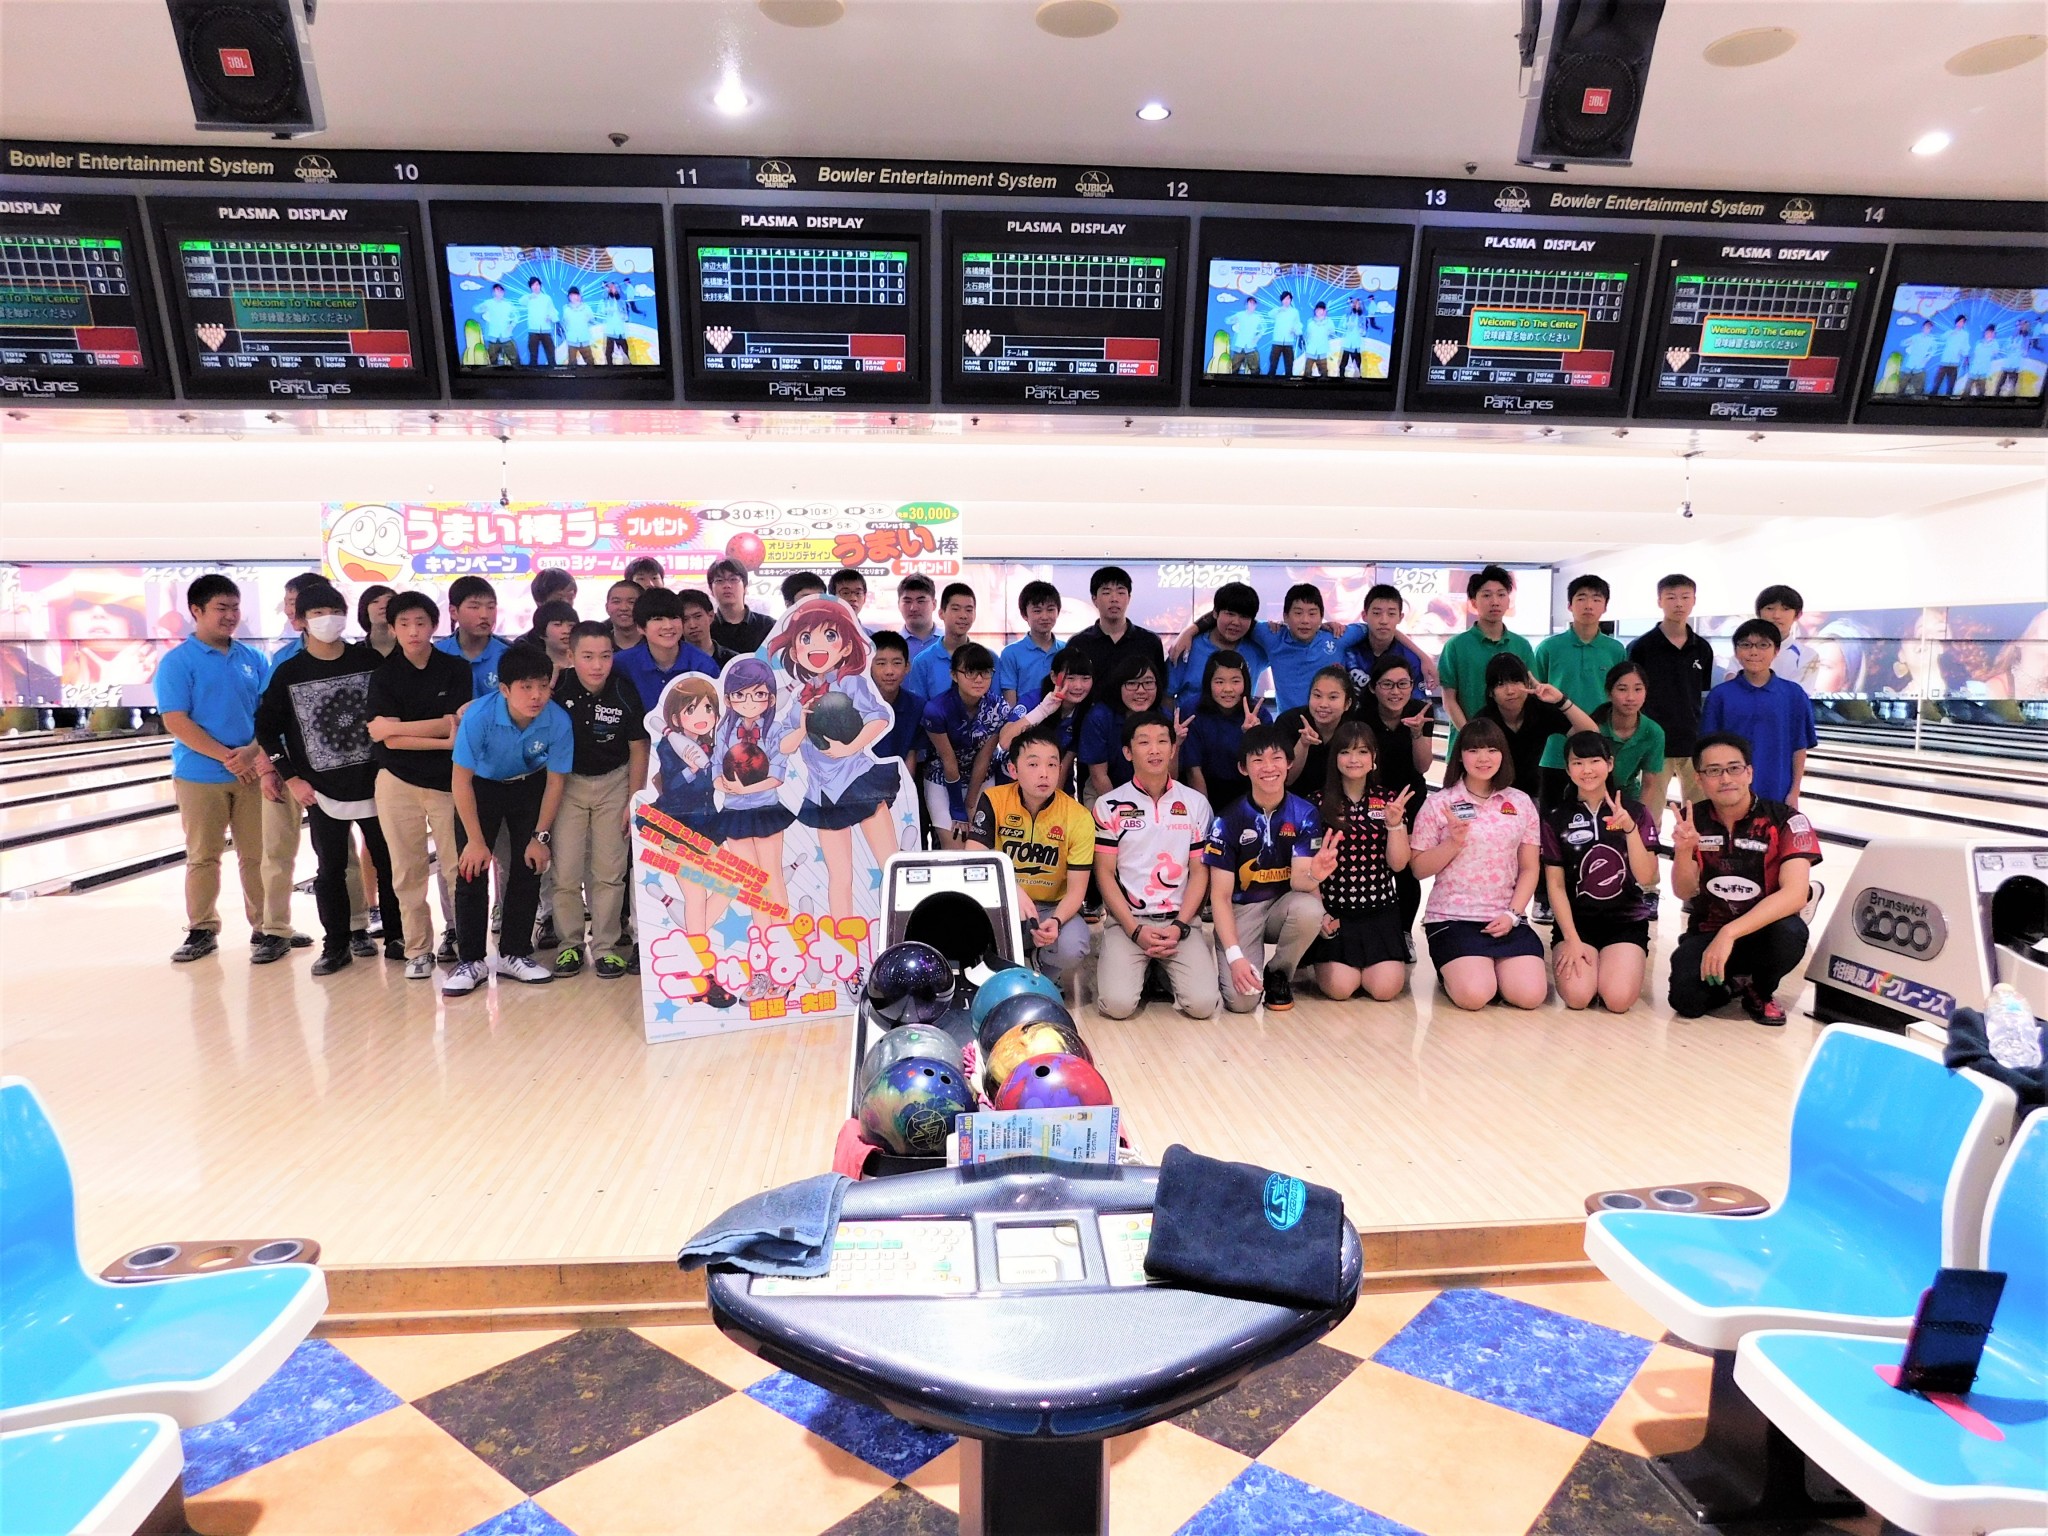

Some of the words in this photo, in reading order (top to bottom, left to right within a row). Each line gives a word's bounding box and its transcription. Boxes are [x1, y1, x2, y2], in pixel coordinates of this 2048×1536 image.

[228, 56, 247, 69] JBL
[1589, 96, 1604, 107] JBL
[9, 150, 73, 169] Bowler
[79, 154, 204, 174] Entertainment
[209, 158, 275, 178] System
[294, 168, 338, 179] QUBICA
[394, 164, 419, 181] 10
[676, 168, 698, 185] 11
[755, 172, 797, 184] QUBICA
[817, 166, 876, 184] Bowler
[879, 169, 994, 188] Entertainment
[997, 172, 1058, 190] System
[1074, 182, 1115, 194] QUBICA
[1166, 182, 1189, 198] 12
[1425, 189, 1447, 206] 13
[1494, 198, 1531, 209] QUBICA
[0, 202, 62, 215] DISPLAY
[1550, 192, 1602, 210] Bowler
[1605, 195, 1707, 215] Entertainment
[1710, 200, 1765, 219] System
[218, 207, 280, 220] PLASMA
[288, 208, 349, 221] DISPLAY
[1780, 209, 1815, 221] QUBICA
[1864, 206, 1886, 223] 14
[741, 215, 798, 227] PLASMA
[806, 217, 864, 229] DISPLAY
[1007, 221, 1063, 233] PLASMA
[1070, 222, 1126, 235] DISPLAY
[1484, 236, 1536, 249] PLASMA
[1543, 239, 1596, 251] DISPLAY
[1721, 246, 1771, 259] PLASMA
[1778, 249, 1829, 261] DISPLAY
[241, 299, 285, 308] Welcome
[288, 299, 301, 308] To
[304, 299, 322, 308] The
[324, 300, 357, 309] Center
[1478, 318, 1517, 327] Welcome
[1520, 318, 1530, 327] To
[1533, 320, 1548, 328] The
[1550, 320, 1578, 329] Center
[1711, 326, 1747, 335] Welcome
[1750, 327, 1760, 335] To
[1763, 327, 1777, 336] The
[1779, 328, 1807, 337] Center
[34, 378, 79, 392] Lanes
[270, 380, 307, 394] Park
[308, 380, 351, 394] Lanes
[769, 382, 802, 396] Park
[805, 383, 846, 396] Lanes
[1025, 386, 1057, 399] Park
[1060, 386, 1100, 400] Lanes
[1484, 396, 1514, 408] Park
[1517, 397, 1554, 410] Lanes
[1710, 403, 1740, 416] Park
[1742, 404, 1778, 417] Lanes
[626, 516, 689, 537] プレゼント
[768, 542, 811, 550] オリジナル
[767, 551, 831, 560] ボウリングデザイン
[425, 555, 518, 573] キャンペーン
[595, 704, 623, 716] Sports
[595, 712, 620, 724] Magic
[1123, 820, 1142, 828] ABS
[1870, 891, 1928, 918] Brunswick
[1861, 905, 1932, 951] 2000
[1832, 960, 1951, 1015] 相模原パークレーンズ
